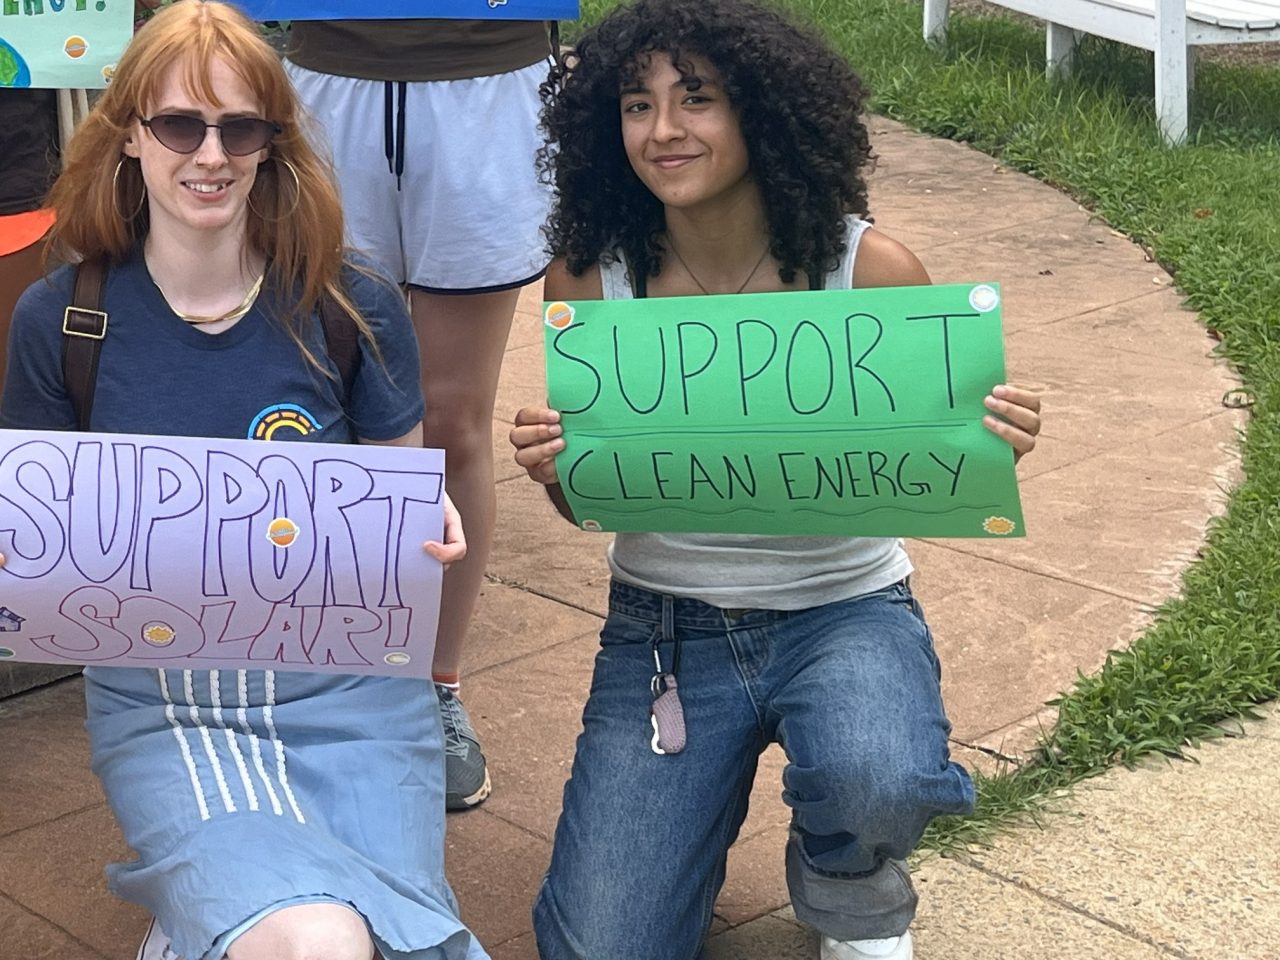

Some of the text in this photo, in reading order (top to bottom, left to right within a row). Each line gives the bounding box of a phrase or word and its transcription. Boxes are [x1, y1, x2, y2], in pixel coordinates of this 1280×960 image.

[552, 312, 981, 417] SUPPORT
[568, 449, 967, 502] CLEAN ENERGY
[29, 585, 414, 667] SOLAR!
